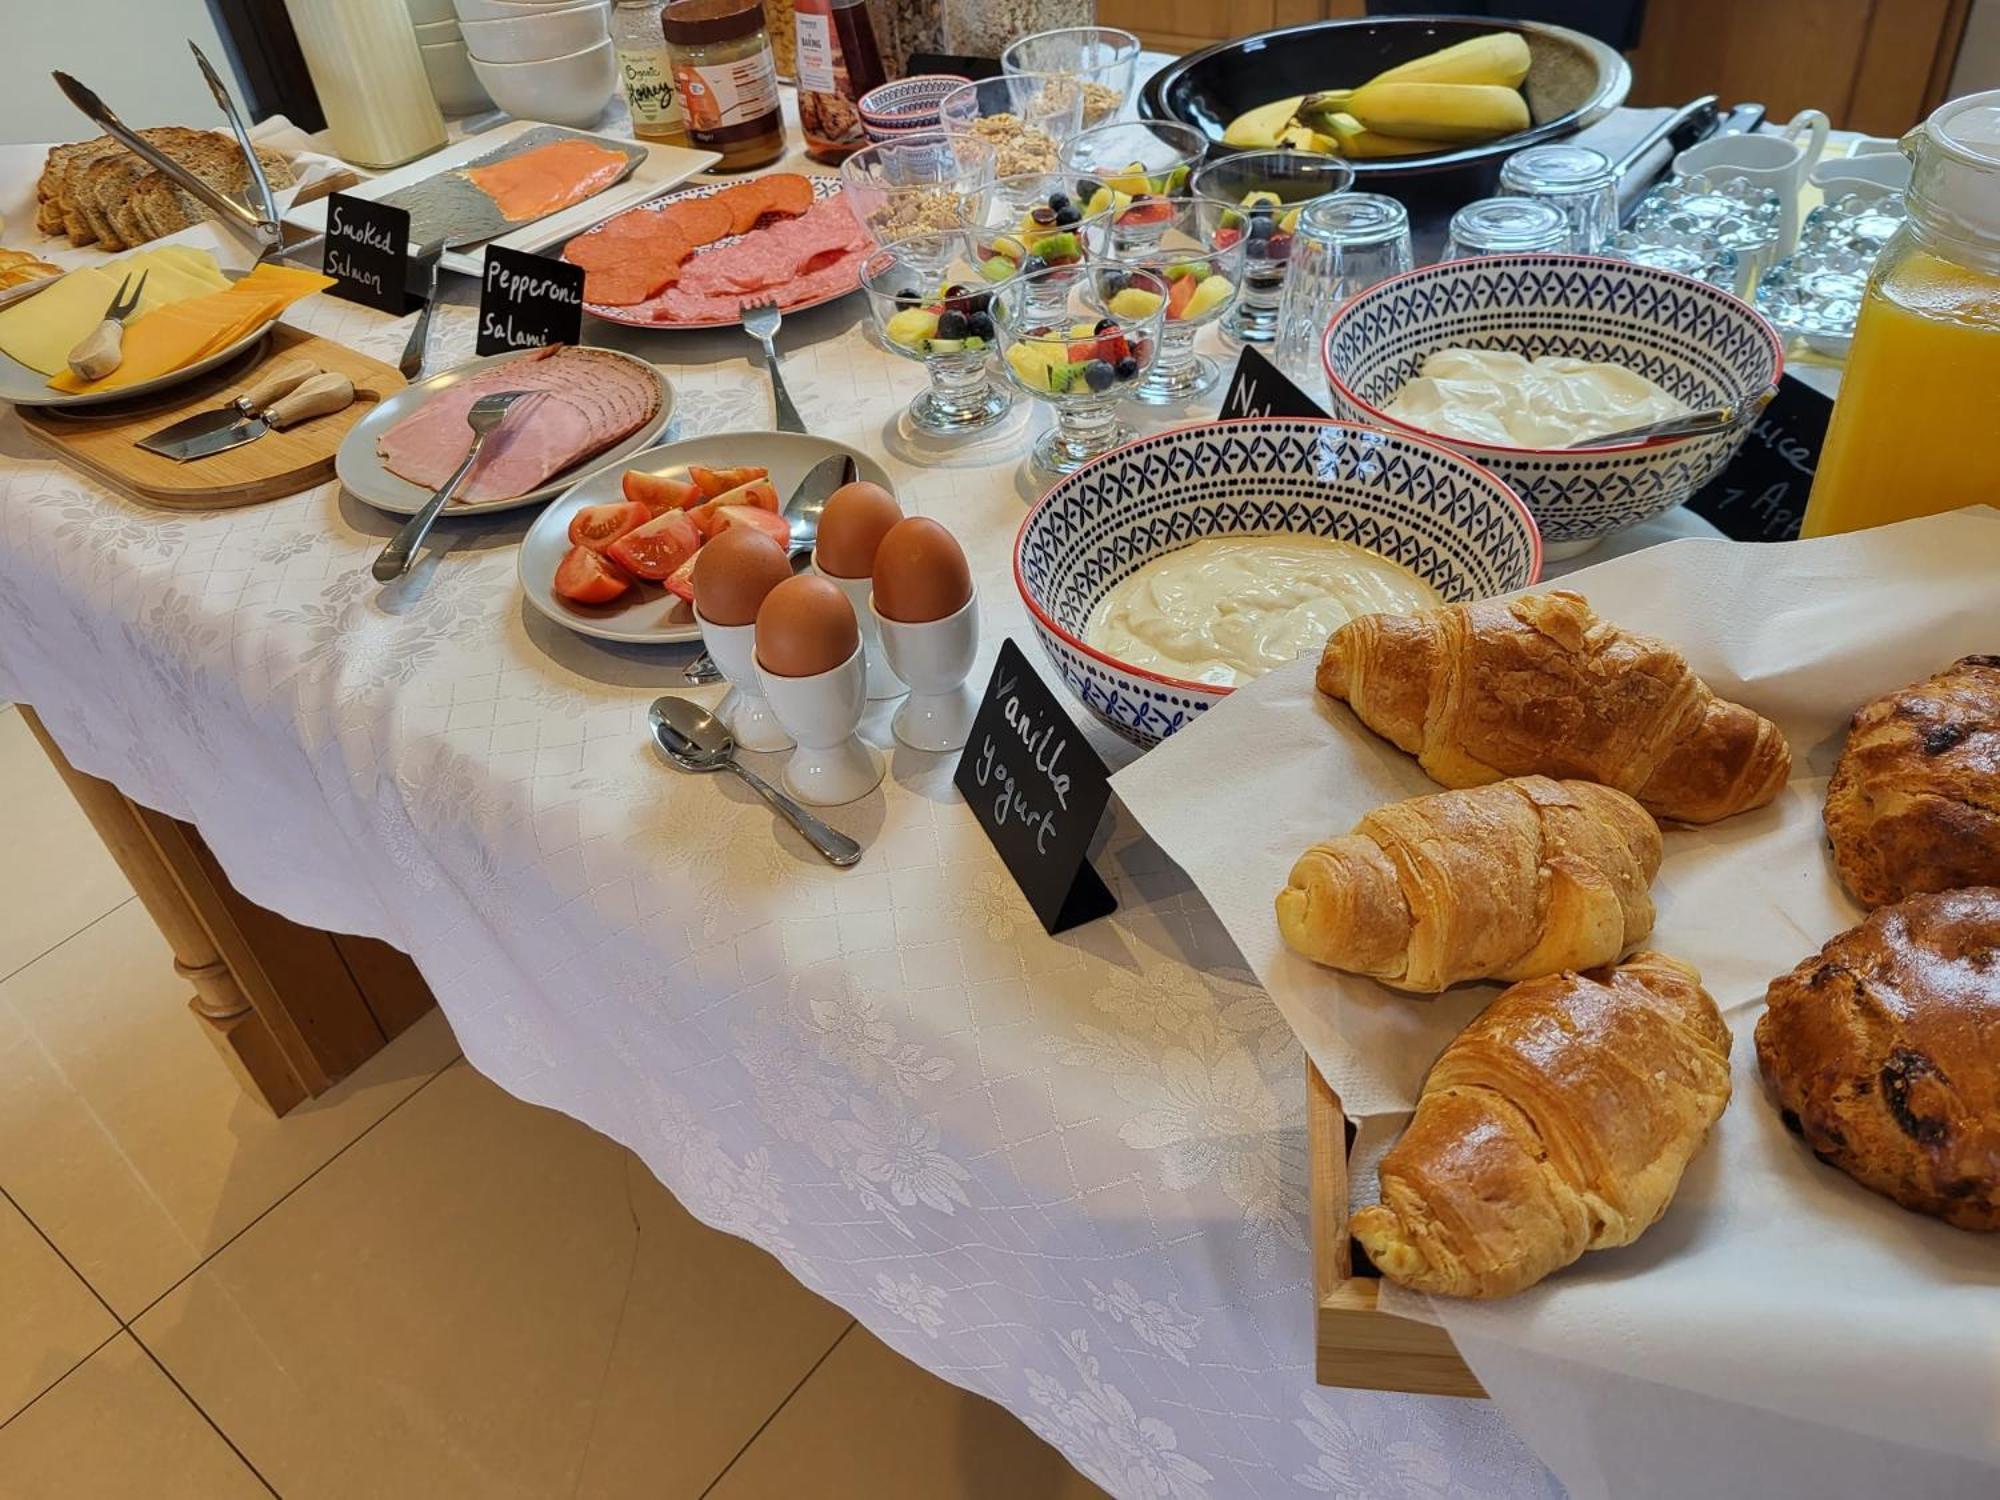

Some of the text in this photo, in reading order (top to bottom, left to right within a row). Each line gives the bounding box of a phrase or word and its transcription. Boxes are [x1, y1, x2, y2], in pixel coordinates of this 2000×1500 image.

[325, 250, 383, 295] Salmon
[487, 260, 581, 305] Pepperoni
[482, 313, 549, 347] Salami
[1751, 415, 1816, 476] uice
[994, 665, 1071, 811] Vanilla
[975, 733, 1057, 855] yogurt
